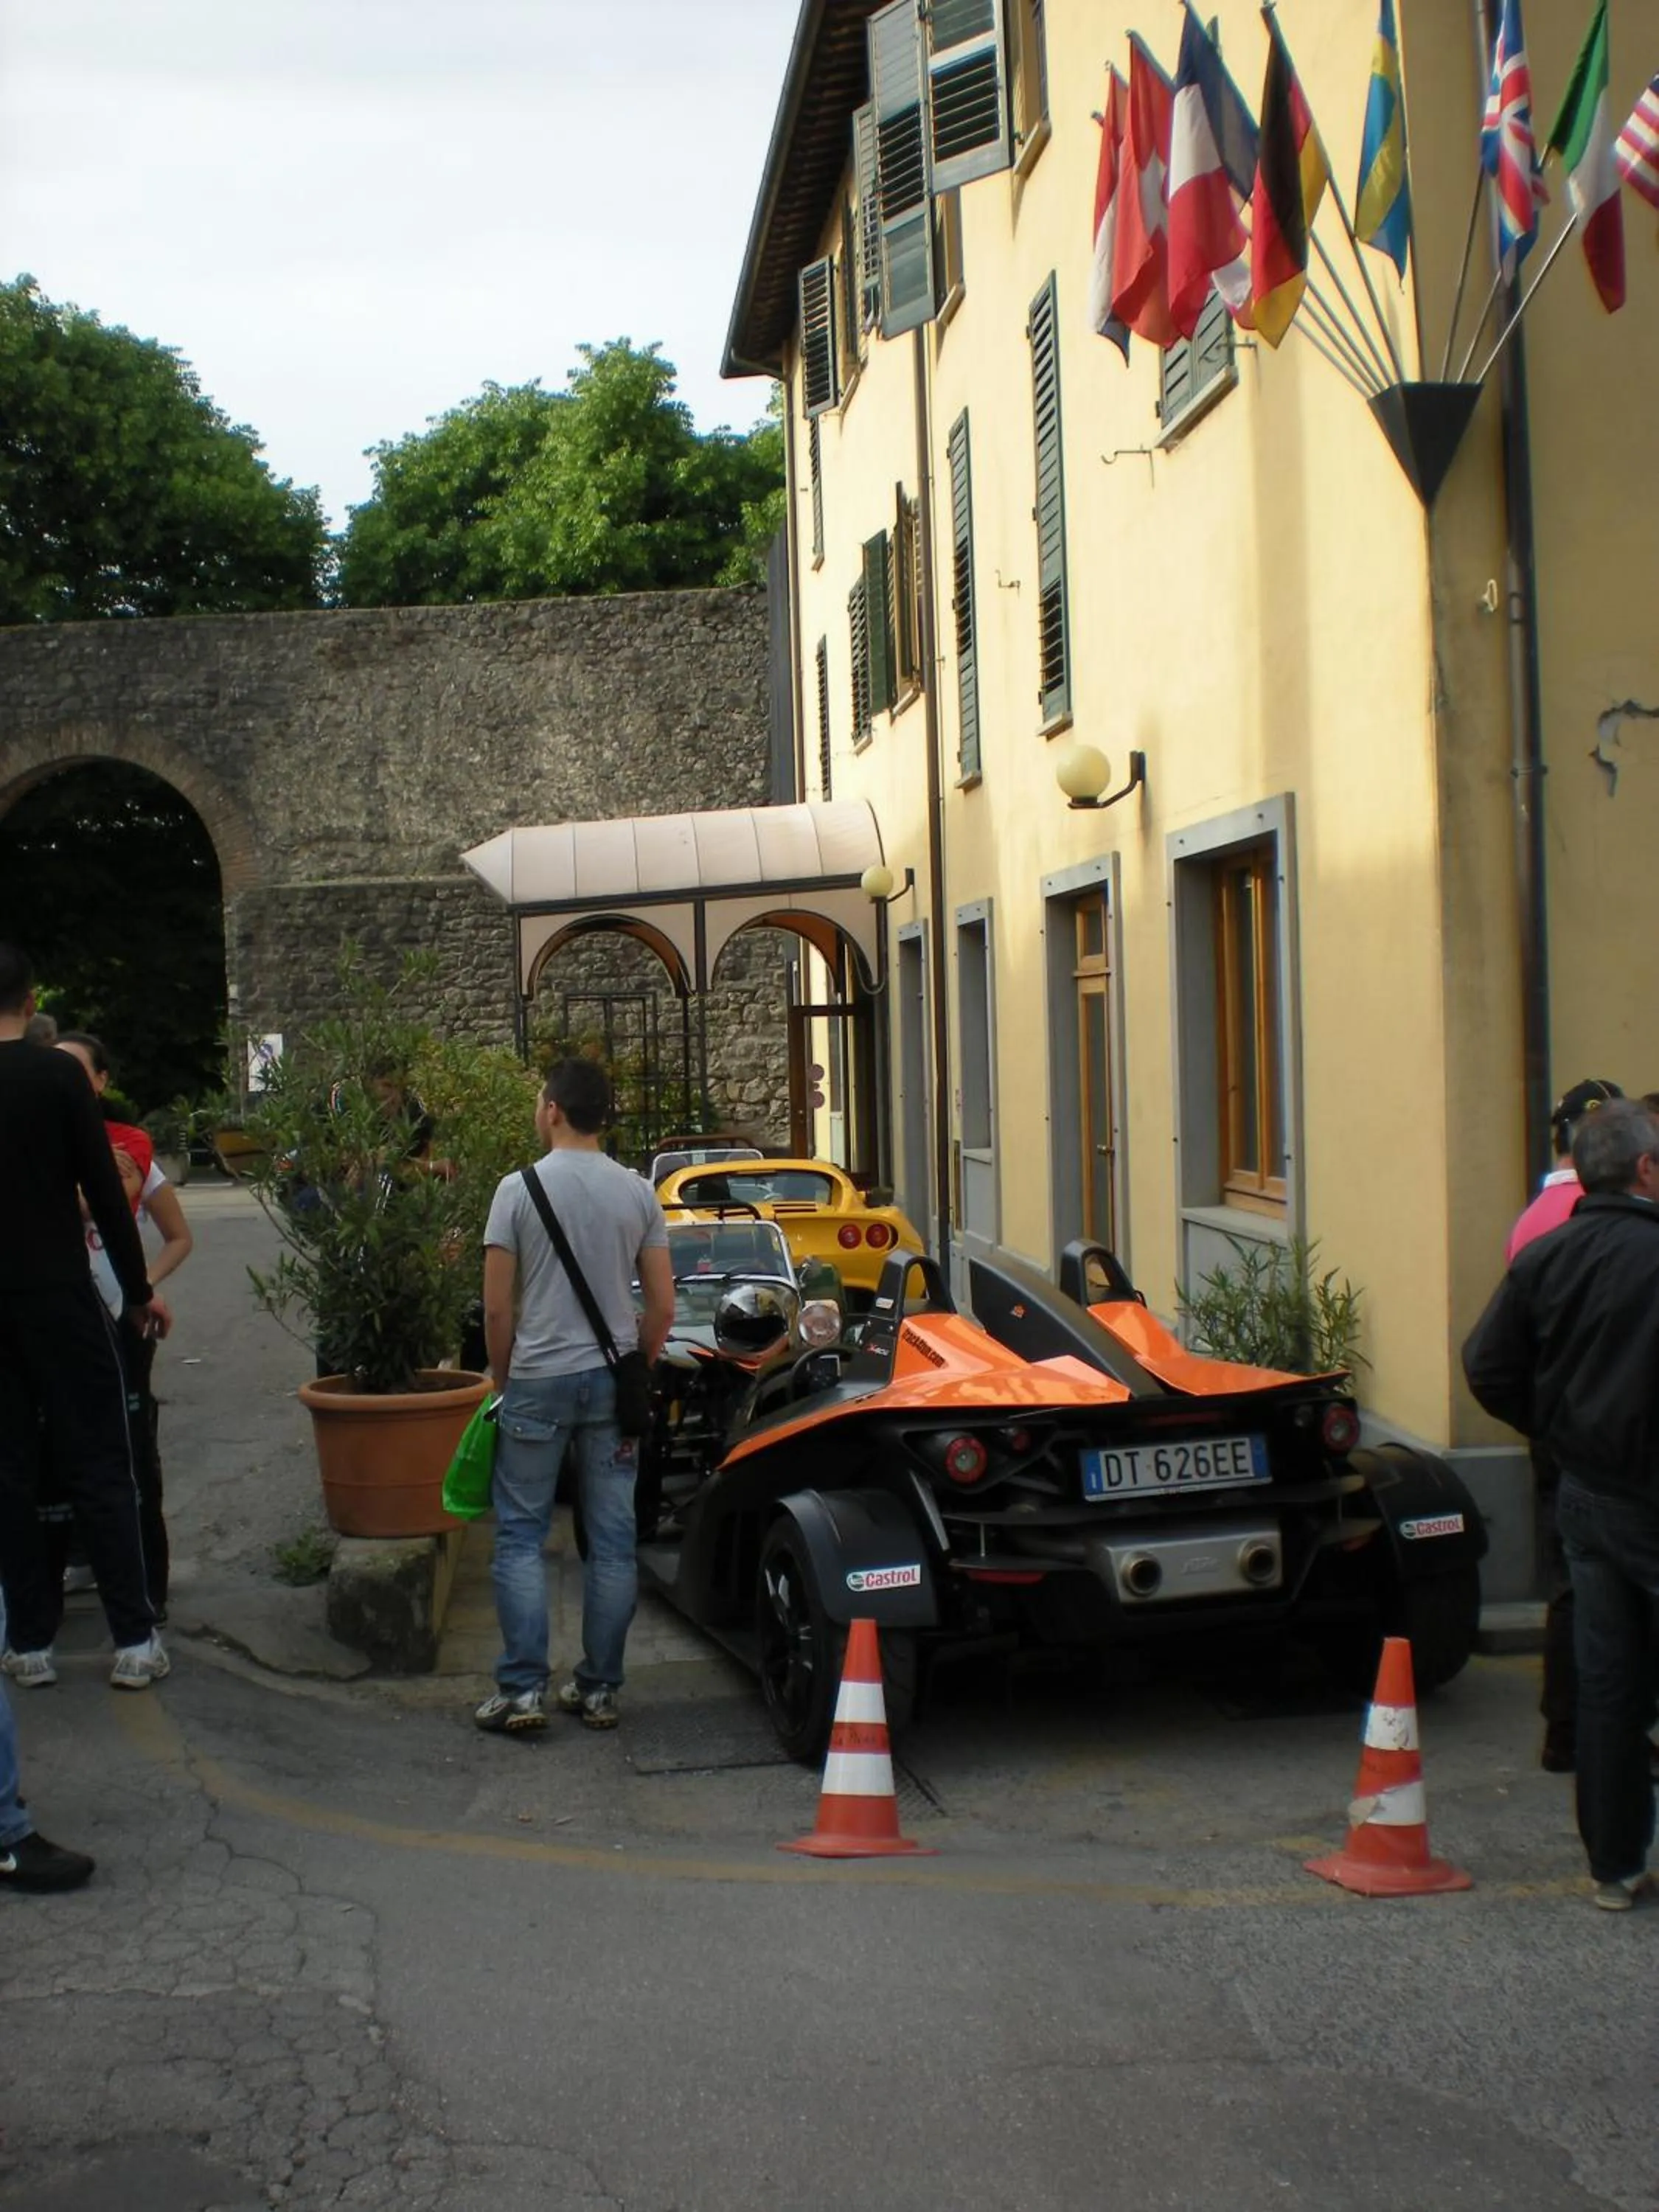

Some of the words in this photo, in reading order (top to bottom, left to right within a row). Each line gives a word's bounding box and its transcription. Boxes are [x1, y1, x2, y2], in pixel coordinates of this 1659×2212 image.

[1105, 1453, 1140, 1487] DT
[1153, 1441, 1250, 1482] 626EE
[1416, 1517, 1460, 1535] Castrol
[866, 1568, 917, 1587] Castrol
